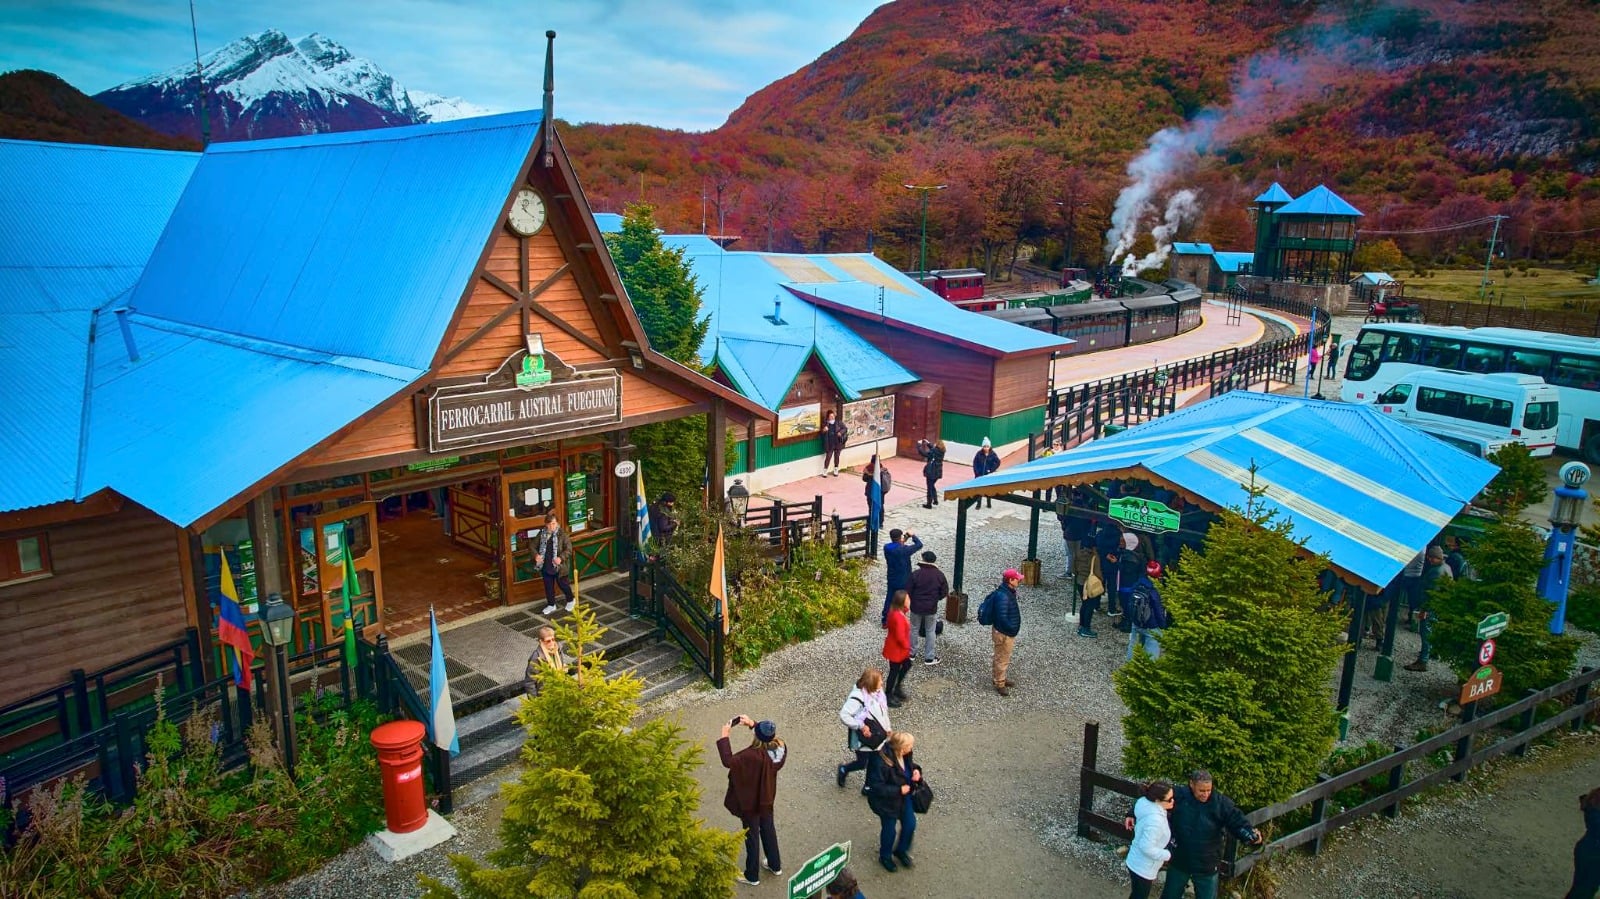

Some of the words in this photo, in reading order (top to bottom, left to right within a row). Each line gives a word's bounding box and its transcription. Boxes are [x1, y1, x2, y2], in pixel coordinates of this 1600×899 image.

[441, 401, 514, 431] FERROCARRIL
[518, 395, 563, 419] AUSTRAL
[568, 388, 615, 412] FUEGUINO
[1570, 469, 1586, 483] YPF
[1123, 510, 1165, 525] TICKETS
[1469, 679, 1494, 697] BAR
